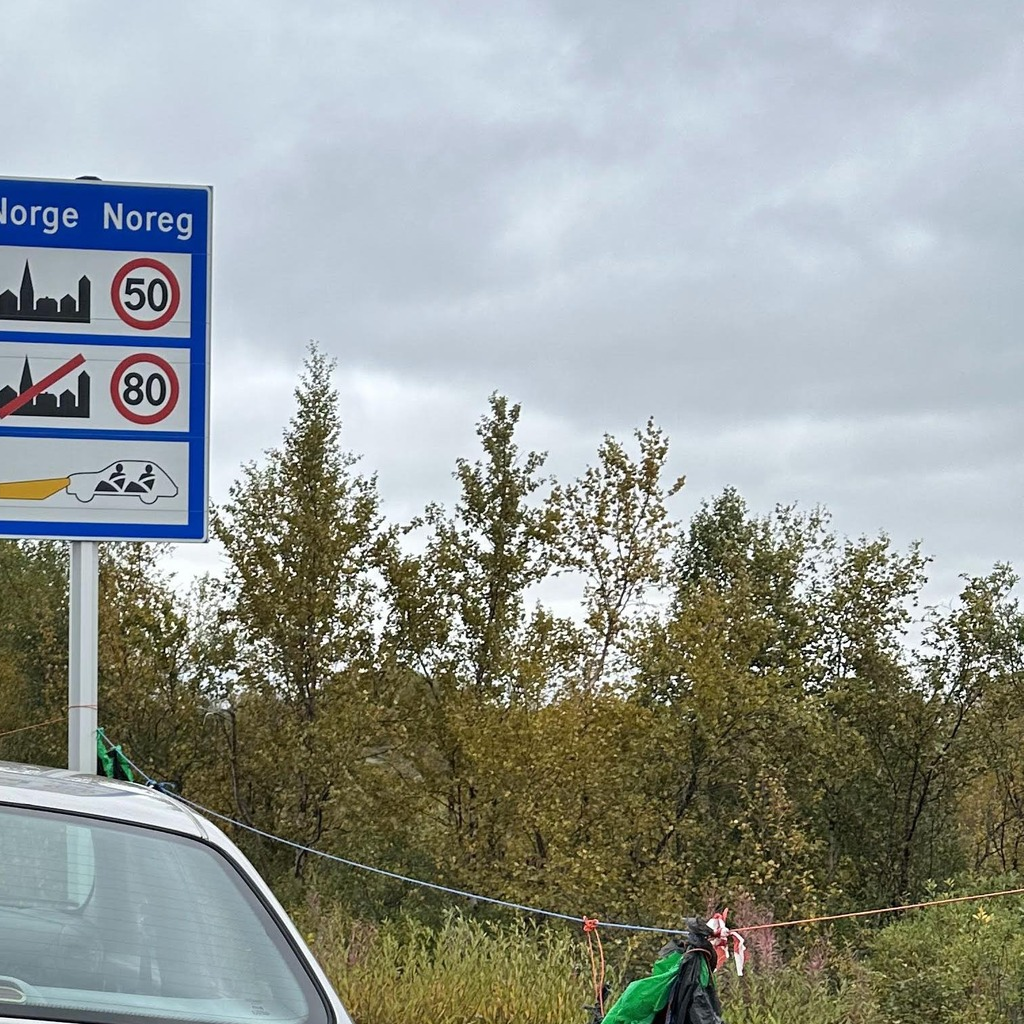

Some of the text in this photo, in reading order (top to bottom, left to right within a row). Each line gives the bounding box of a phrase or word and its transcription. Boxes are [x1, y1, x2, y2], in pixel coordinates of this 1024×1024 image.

[103, 202, 193, 241] Noreg
[124, 278, 169, 312] 50
[123, 372, 167, 407] 80
